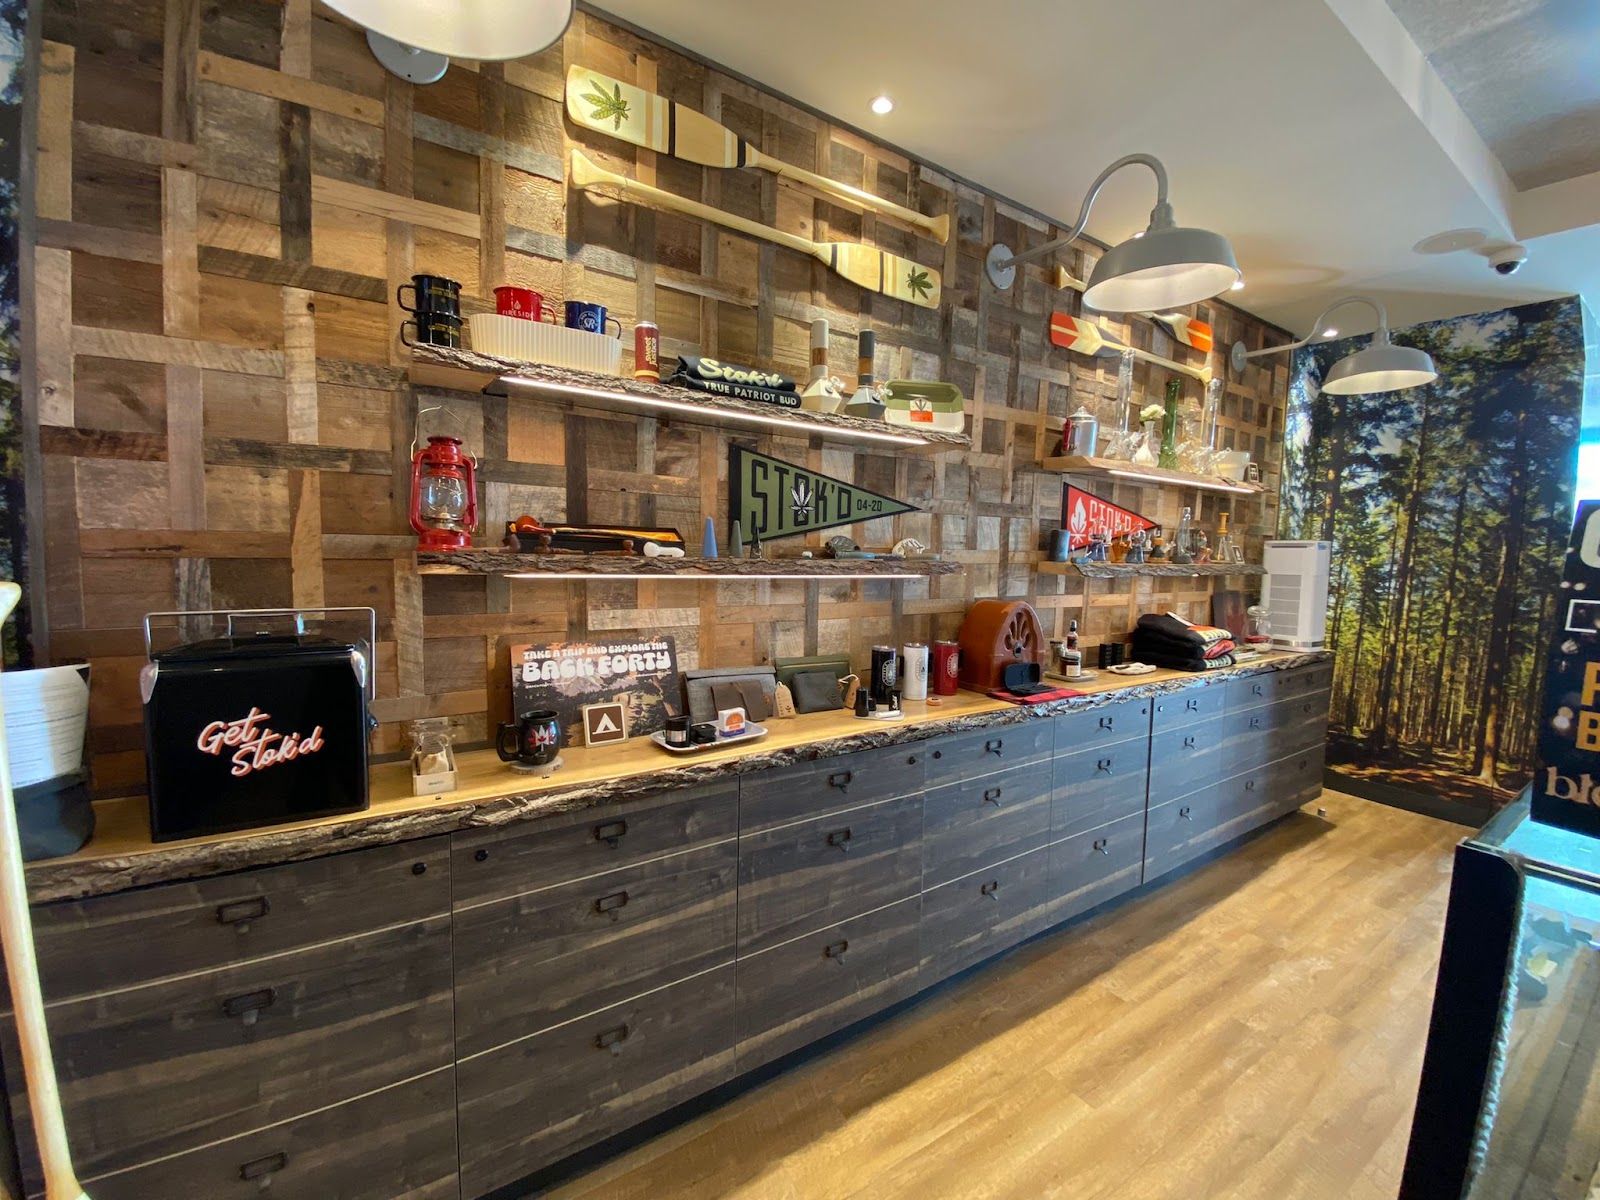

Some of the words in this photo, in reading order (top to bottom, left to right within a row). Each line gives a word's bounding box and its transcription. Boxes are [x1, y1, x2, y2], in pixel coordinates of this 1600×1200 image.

[697, 357, 783, 388] Stok'd
[703, 381, 730, 394] TRUE
[734, 387, 776, 403] PATRIOT
[780, 395, 797, 406] BUD
[751, 459, 851, 534] STOK'D
[857, 499, 883, 512] 04-20
[523, 651, 551, 660] TAKE
[553, 650, 560, 658] A
[560, 647, 584, 658] TRIP
[587, 645, 608, 655] AND
[609, 642, 651, 653] EXPLORE
[651, 641, 668, 650] THE
[522, 658, 595, 682] BACK
[597, 651, 672, 675] FORTY
[197, 707, 271, 756] Get
[231, 725, 325, 777] Stok'd
